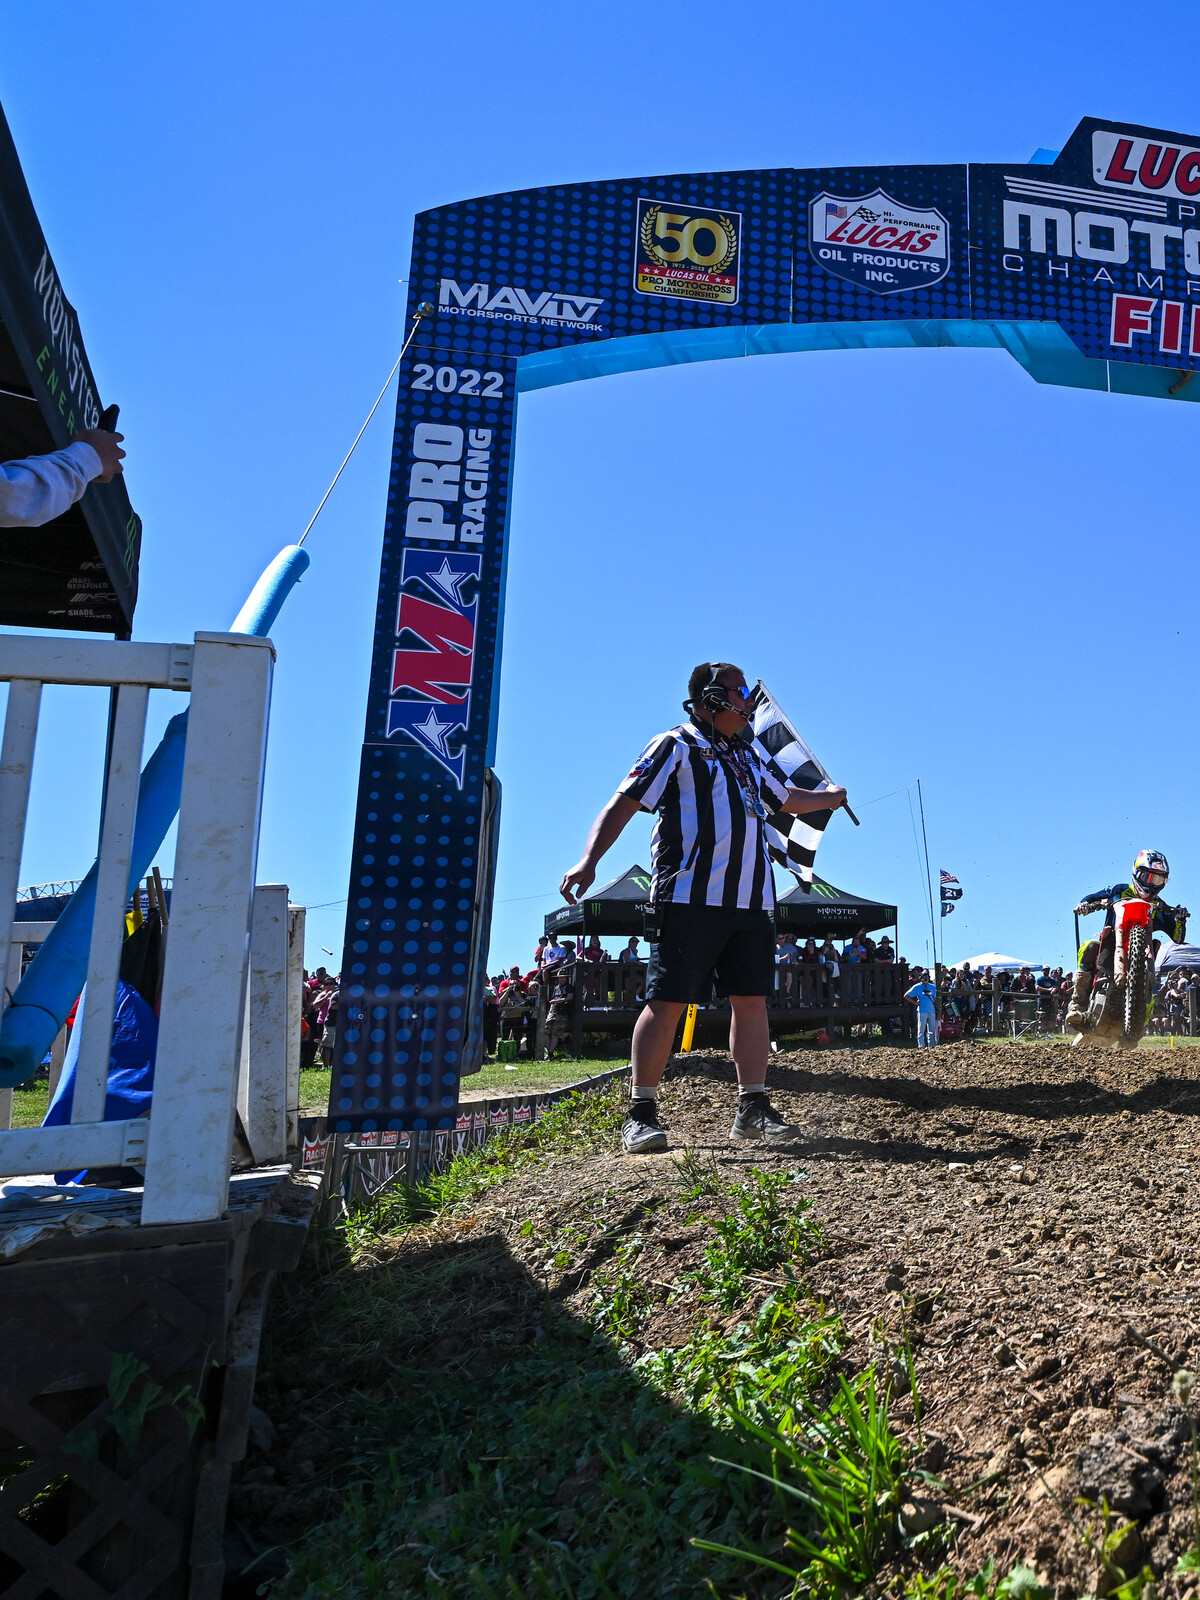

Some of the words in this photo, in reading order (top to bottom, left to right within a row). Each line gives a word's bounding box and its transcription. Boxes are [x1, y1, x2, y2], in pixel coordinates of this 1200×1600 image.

[825, 221, 938, 253] LUCAS
[883, 218, 941, 231] PERFORMANCE
[652, 212, 728, 266] 50
[819, 248, 847, 262] OIL
[852, 252, 940, 273] PRODUCTS
[641, 275, 664, 285] PRO
[666, 279, 732, 294] MOTOCROSS
[665, 269, 695, 280] LUCAS
[695, 273, 710, 282] OIL
[654, 285, 720, 299] CHAMPIONSHIP
[438, 305, 538, 324] MOTORSPORTS
[541, 317, 603, 332] NETWORK
[34, 246, 100, 430] MONSTER
[411, 363, 504, 399] 2022
[405, 422, 464, 541] PRO
[460, 428, 492, 544] RACING
[386, 547, 483, 790] AMA
[817, 907, 859, 916] MONSTER
[306, 1148, 326, 1161] RACER
